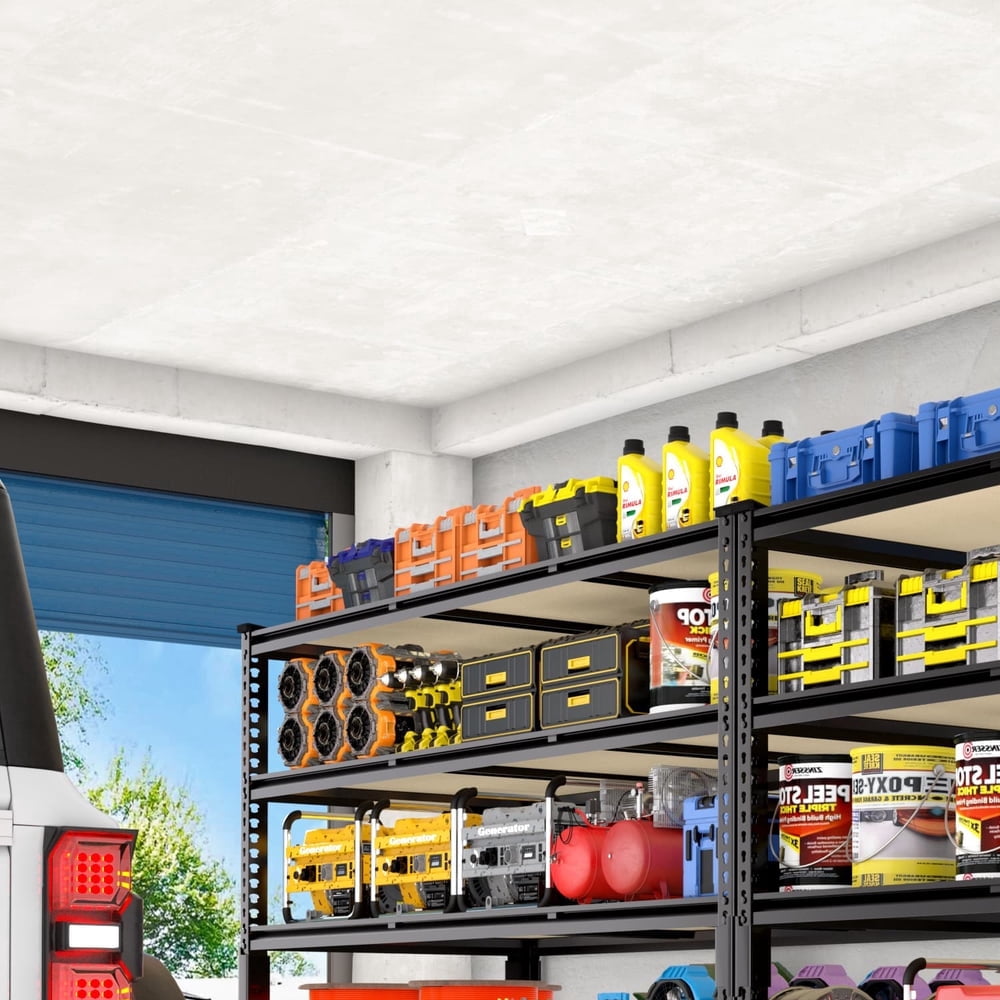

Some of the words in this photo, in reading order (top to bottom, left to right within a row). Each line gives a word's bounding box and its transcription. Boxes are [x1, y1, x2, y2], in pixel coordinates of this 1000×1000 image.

[715, 475, 737, 485] RIMULA
[667, 487, 688, 497] RIMULA
[622, 499, 642, 509] RIMULA
[478, 824, 530, 837] Generator
[388, 834, 437, 845] Generator
[299, 844, 343, 854] Generator
